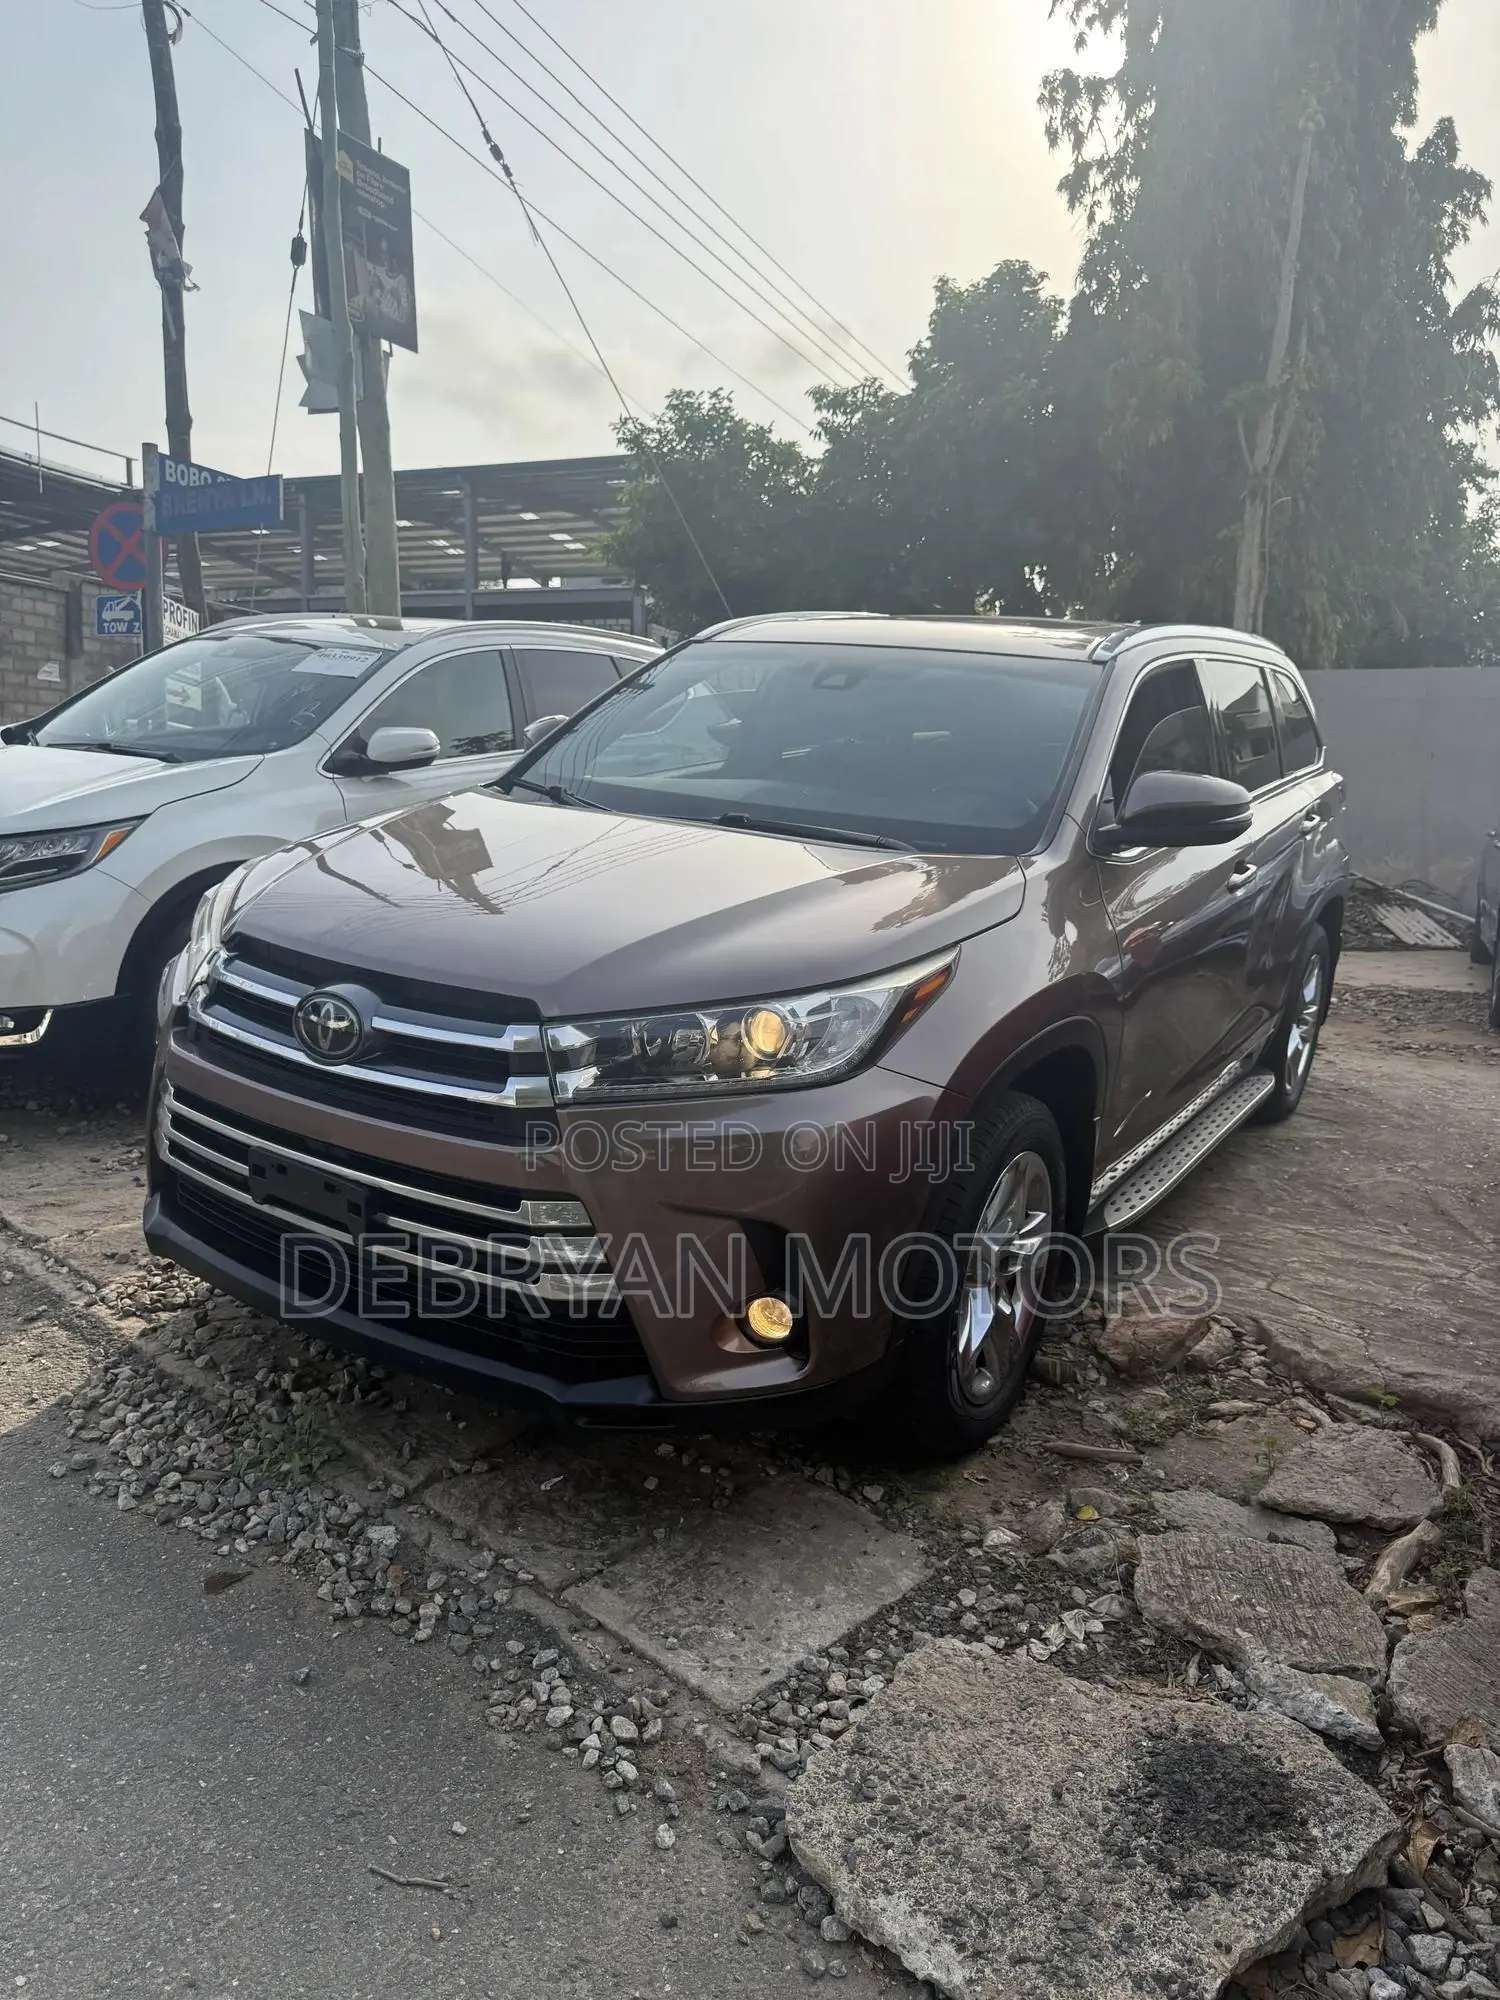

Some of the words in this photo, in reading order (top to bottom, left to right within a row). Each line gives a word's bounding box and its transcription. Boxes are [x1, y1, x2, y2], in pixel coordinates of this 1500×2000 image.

[165, 459, 213, 487] BOBO
[103, 622, 129, 634] TOW
[132, 622, 141, 634] Z
